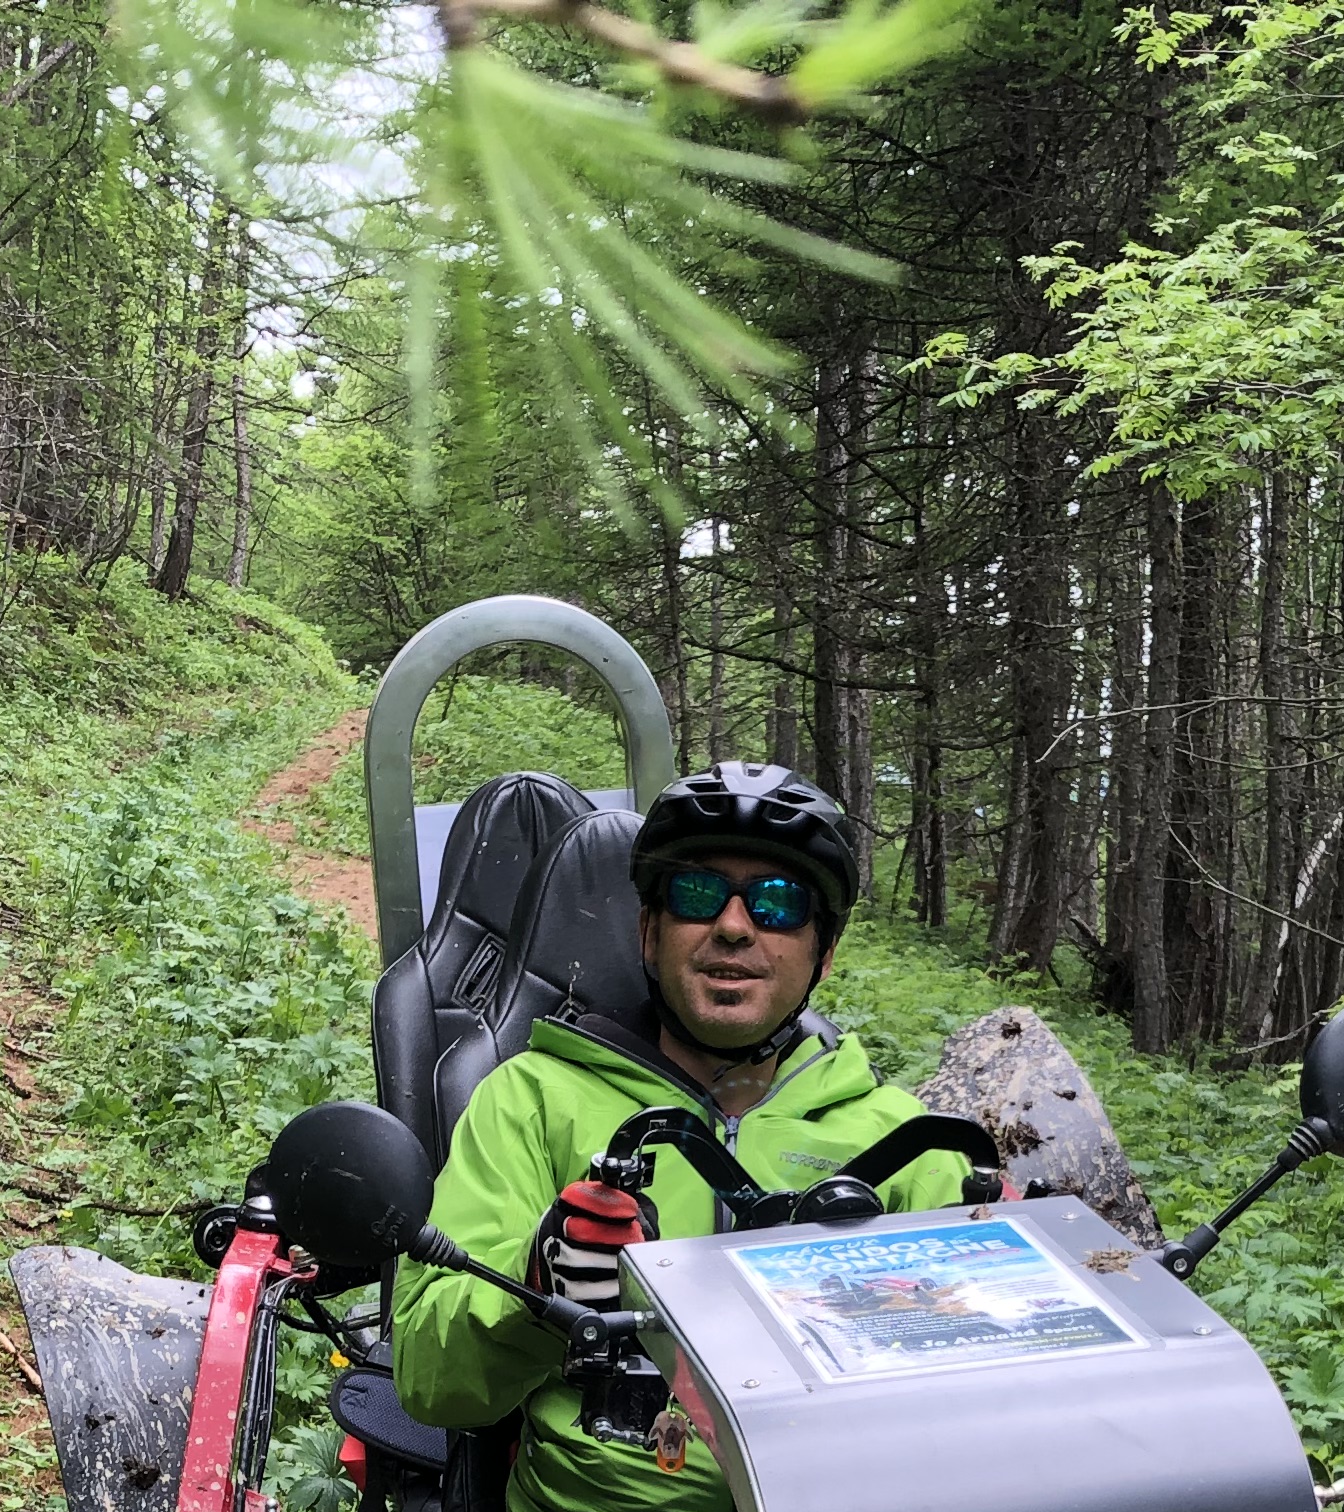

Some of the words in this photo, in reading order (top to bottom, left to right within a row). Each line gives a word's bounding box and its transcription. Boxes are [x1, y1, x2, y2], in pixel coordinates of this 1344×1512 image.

[777, 1238, 946, 1270] RANDOS
[787, 1239, 1011, 1278] MONTAGNE
[920, 1339, 948, 1348] Jo
[953, 1328, 1039, 1345] Arnaud
